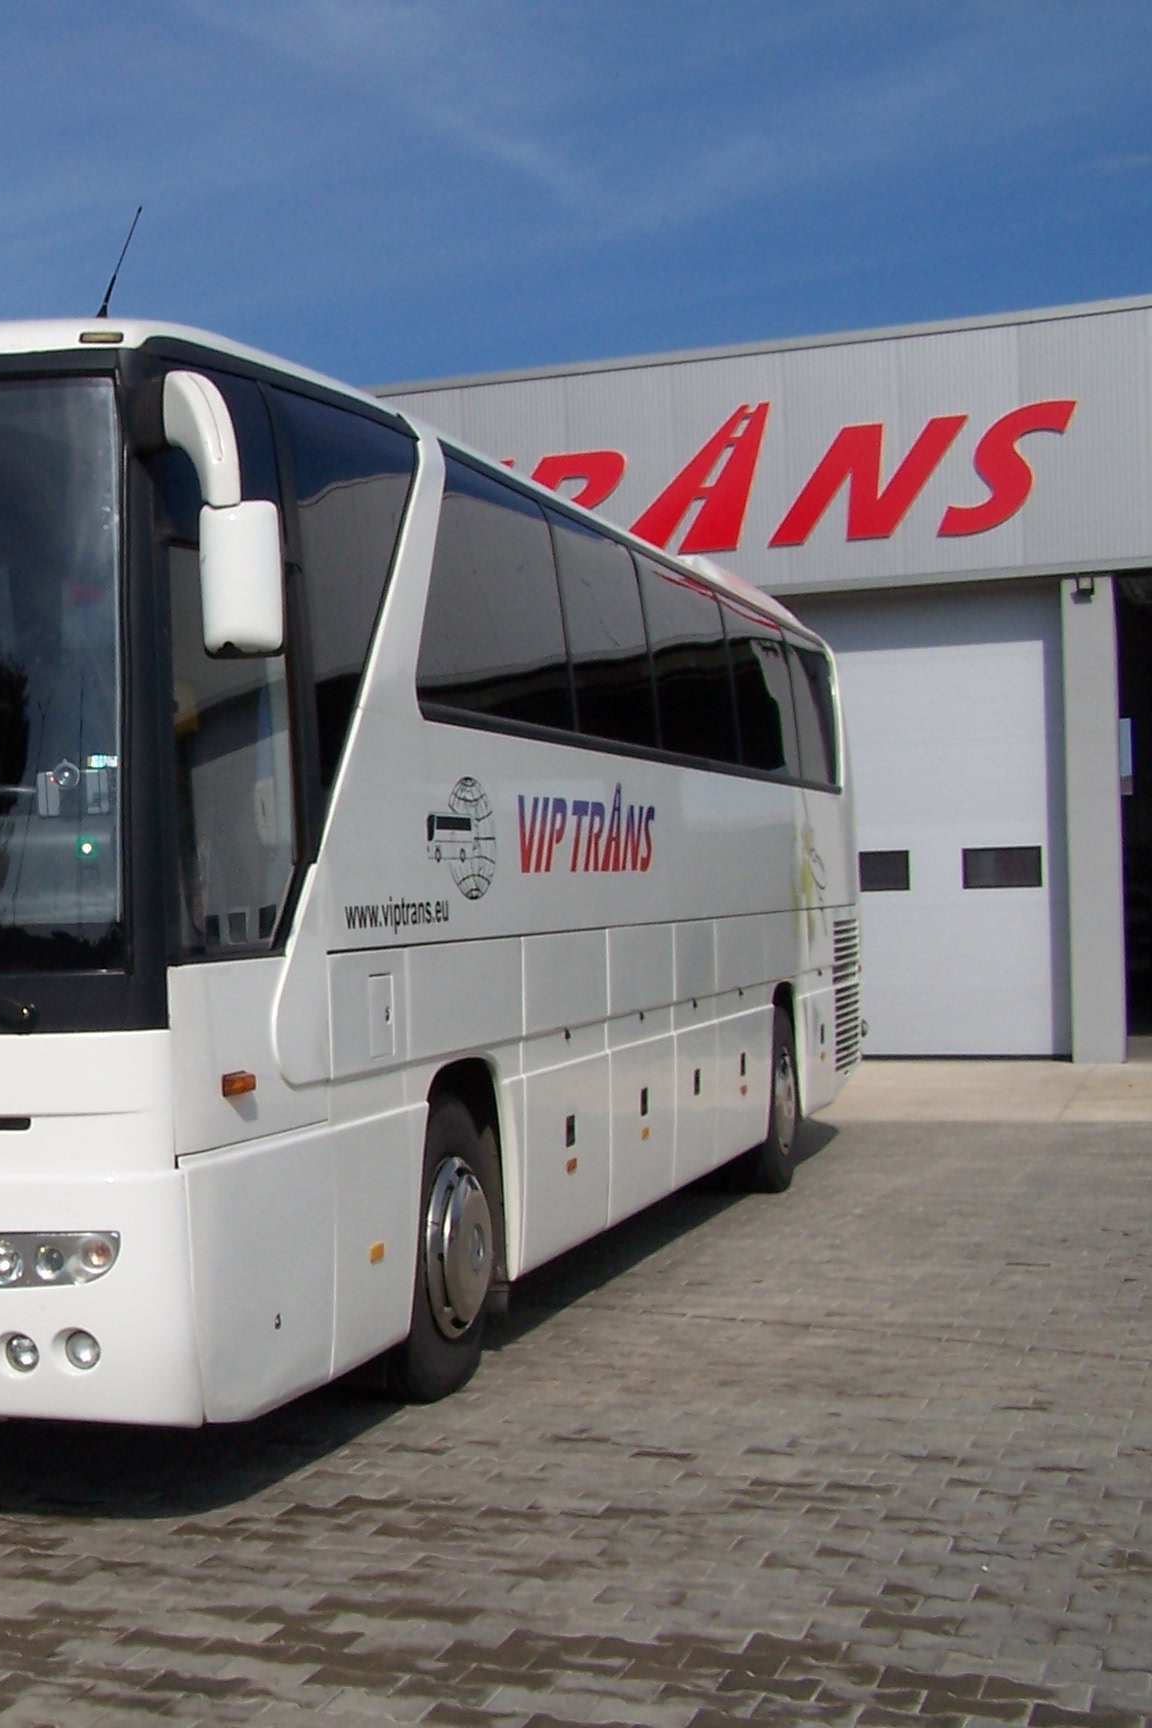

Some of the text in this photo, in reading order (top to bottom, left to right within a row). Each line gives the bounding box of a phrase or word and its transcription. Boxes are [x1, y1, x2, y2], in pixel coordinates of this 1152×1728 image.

[500, 400, 1077, 555] RANS
[517, 782, 655, 874] VIP TRANS
[344, 896, 450, 935] www.viptrans.eu
